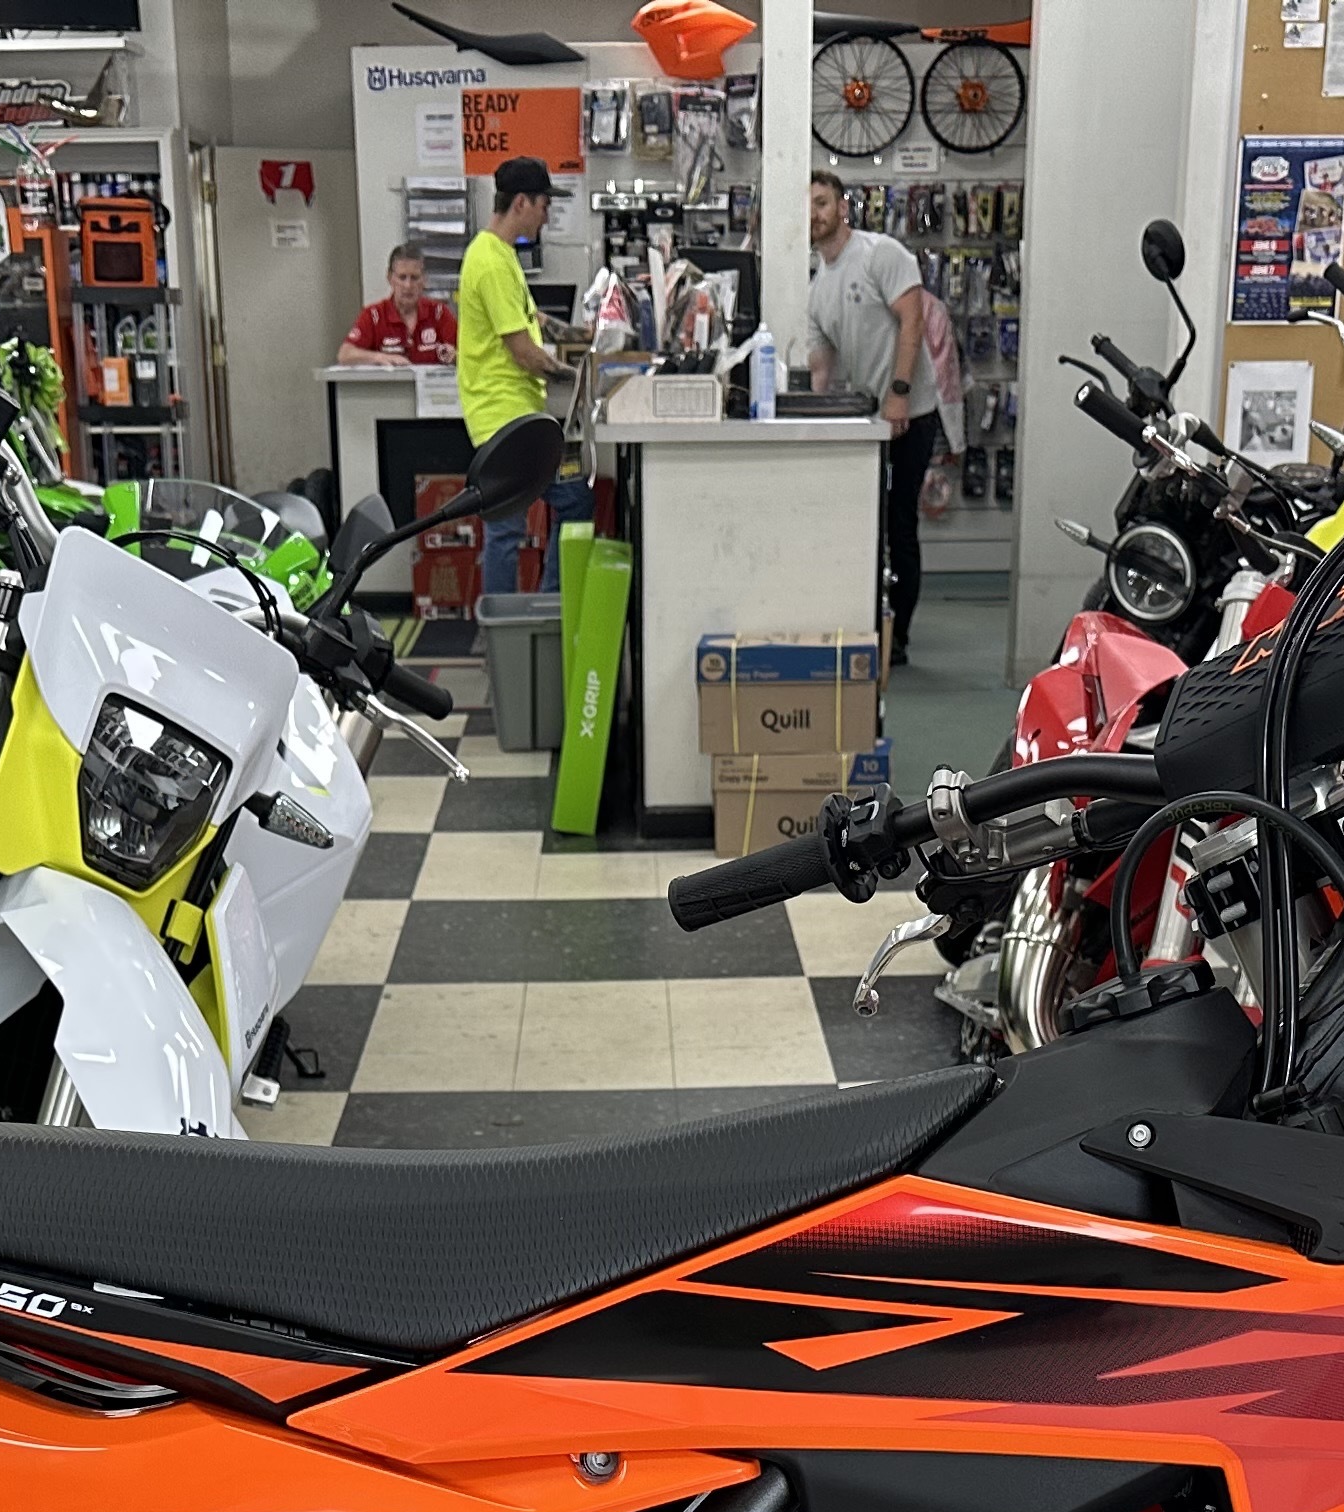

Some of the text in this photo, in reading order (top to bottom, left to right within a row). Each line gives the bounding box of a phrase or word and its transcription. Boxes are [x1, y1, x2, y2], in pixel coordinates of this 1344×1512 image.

[388, 68, 487, 88] Husqvarna
[462, 93, 520, 113] READY
[463, 115, 485, 132] TO
[463, 133, 510, 152] RACE
[579, 670, 601, 738] X-GRIP
[760, 708, 811, 734] Quill
[861, 759, 879, 773] 10
